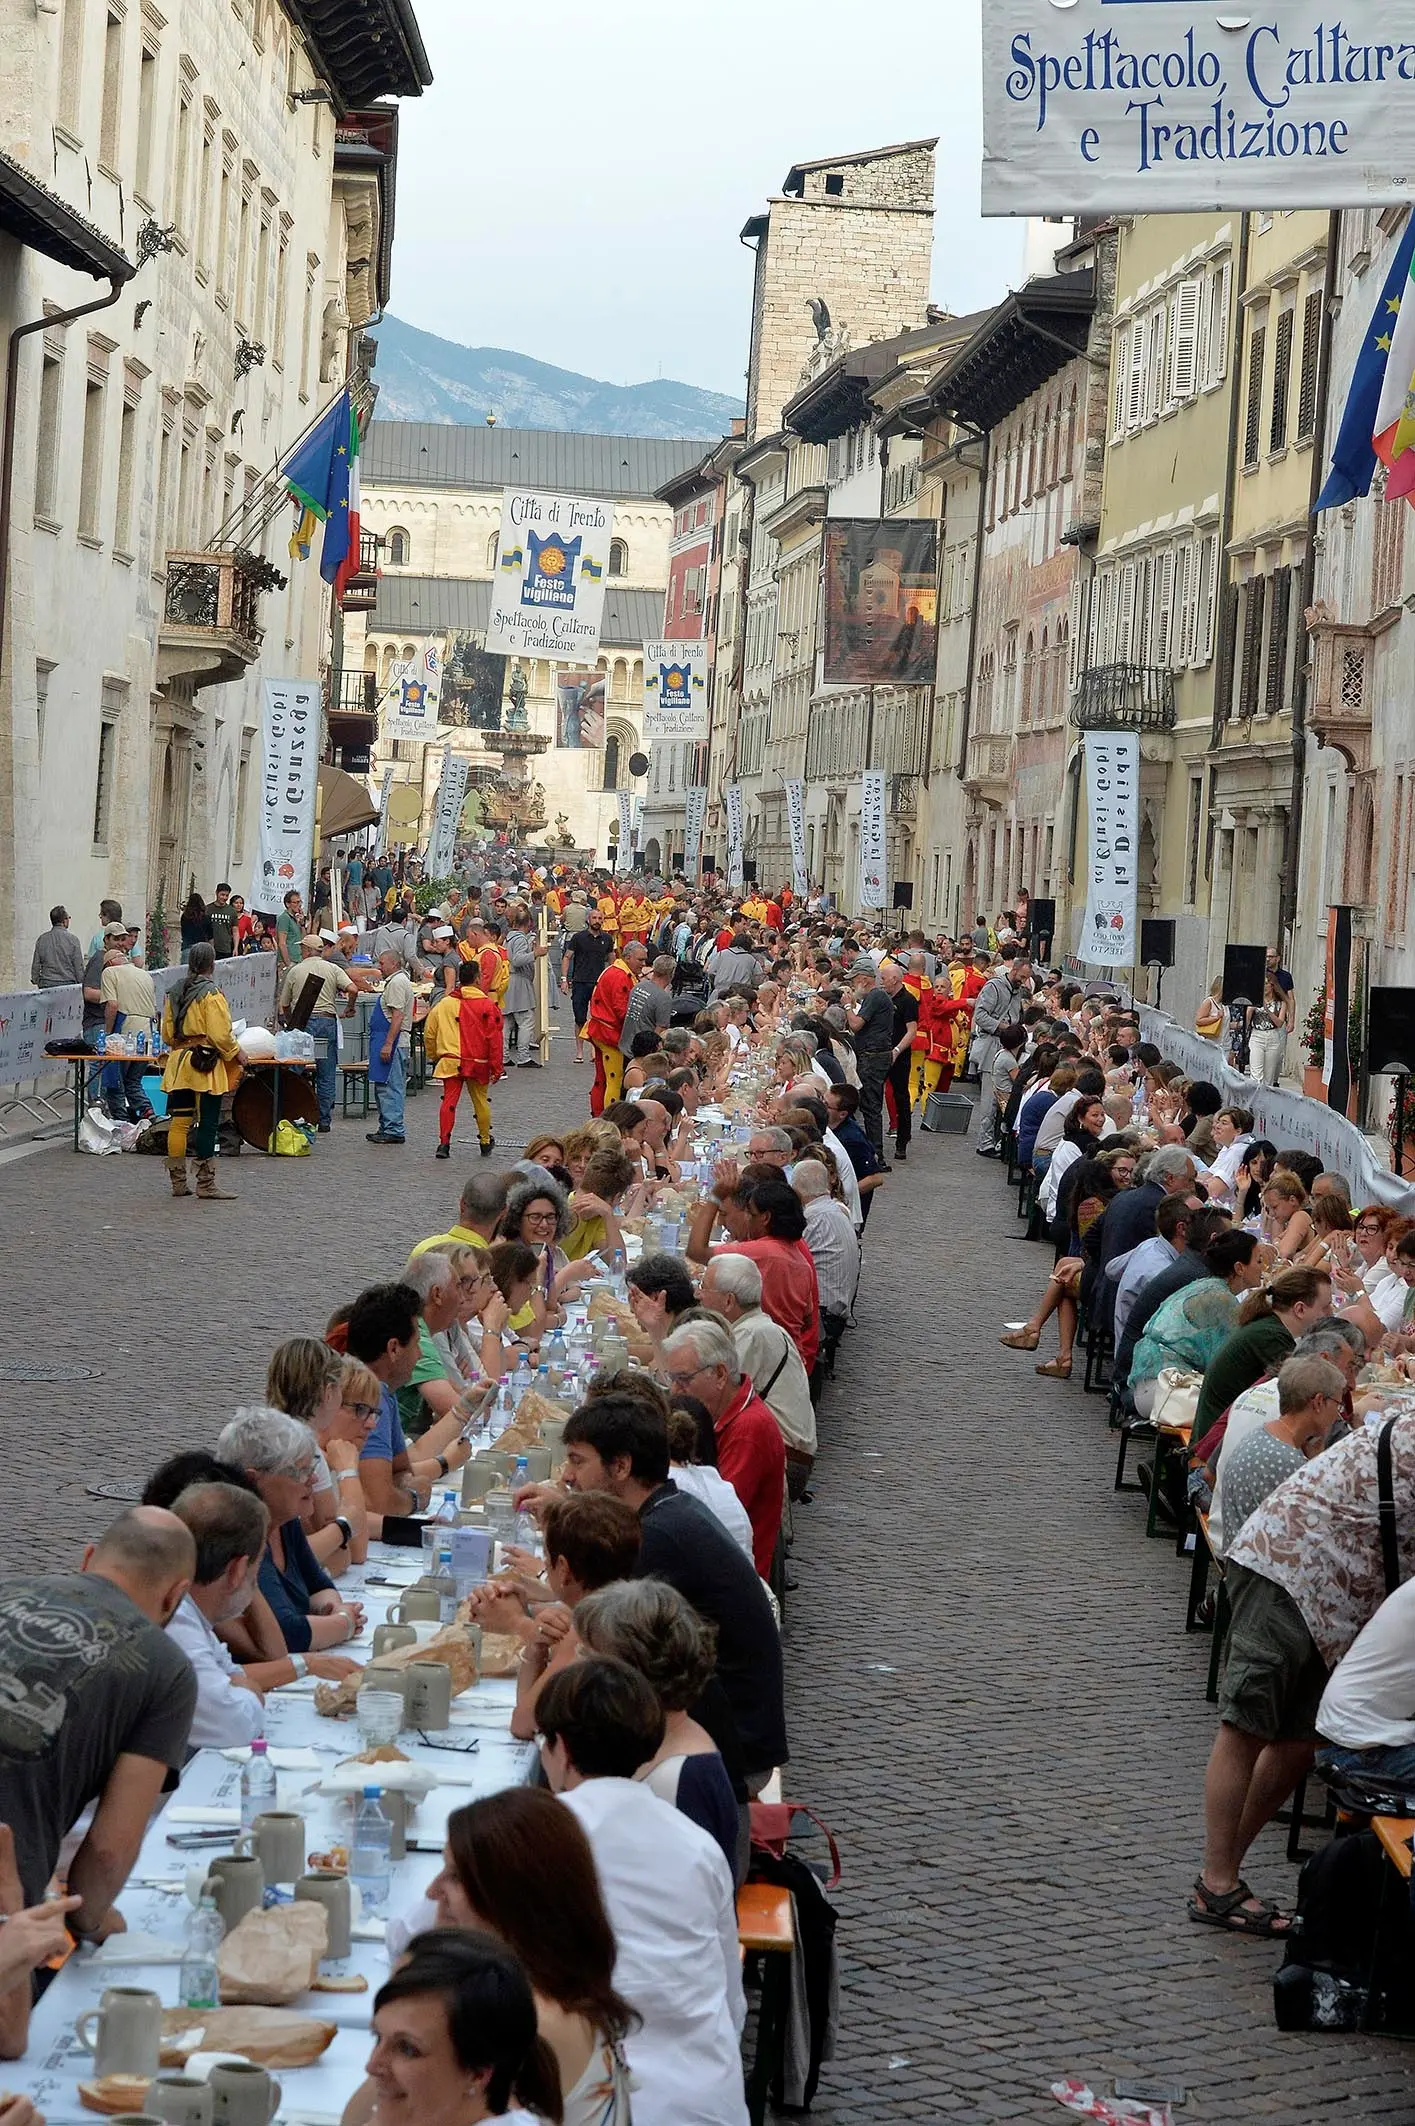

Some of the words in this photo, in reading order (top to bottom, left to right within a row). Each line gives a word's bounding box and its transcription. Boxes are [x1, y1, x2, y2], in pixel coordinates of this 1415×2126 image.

[1005, 25, 1227, 132] Spettacolo,
[1246, 20, 1415, 108] Cultura
[1080, 127, 1100, 162] e
[1124, 93, 1348, 173] Tradizione
[549, 501, 560, 522] di
[568, 502, 606, 528] Trento
[552, 615, 596, 638] Cultura
[509, 634, 516, 644] e
[522, 629, 576, 651] Tradizione
[670, 645, 677, 657] di
[681, 643, 704, 659] Trento
